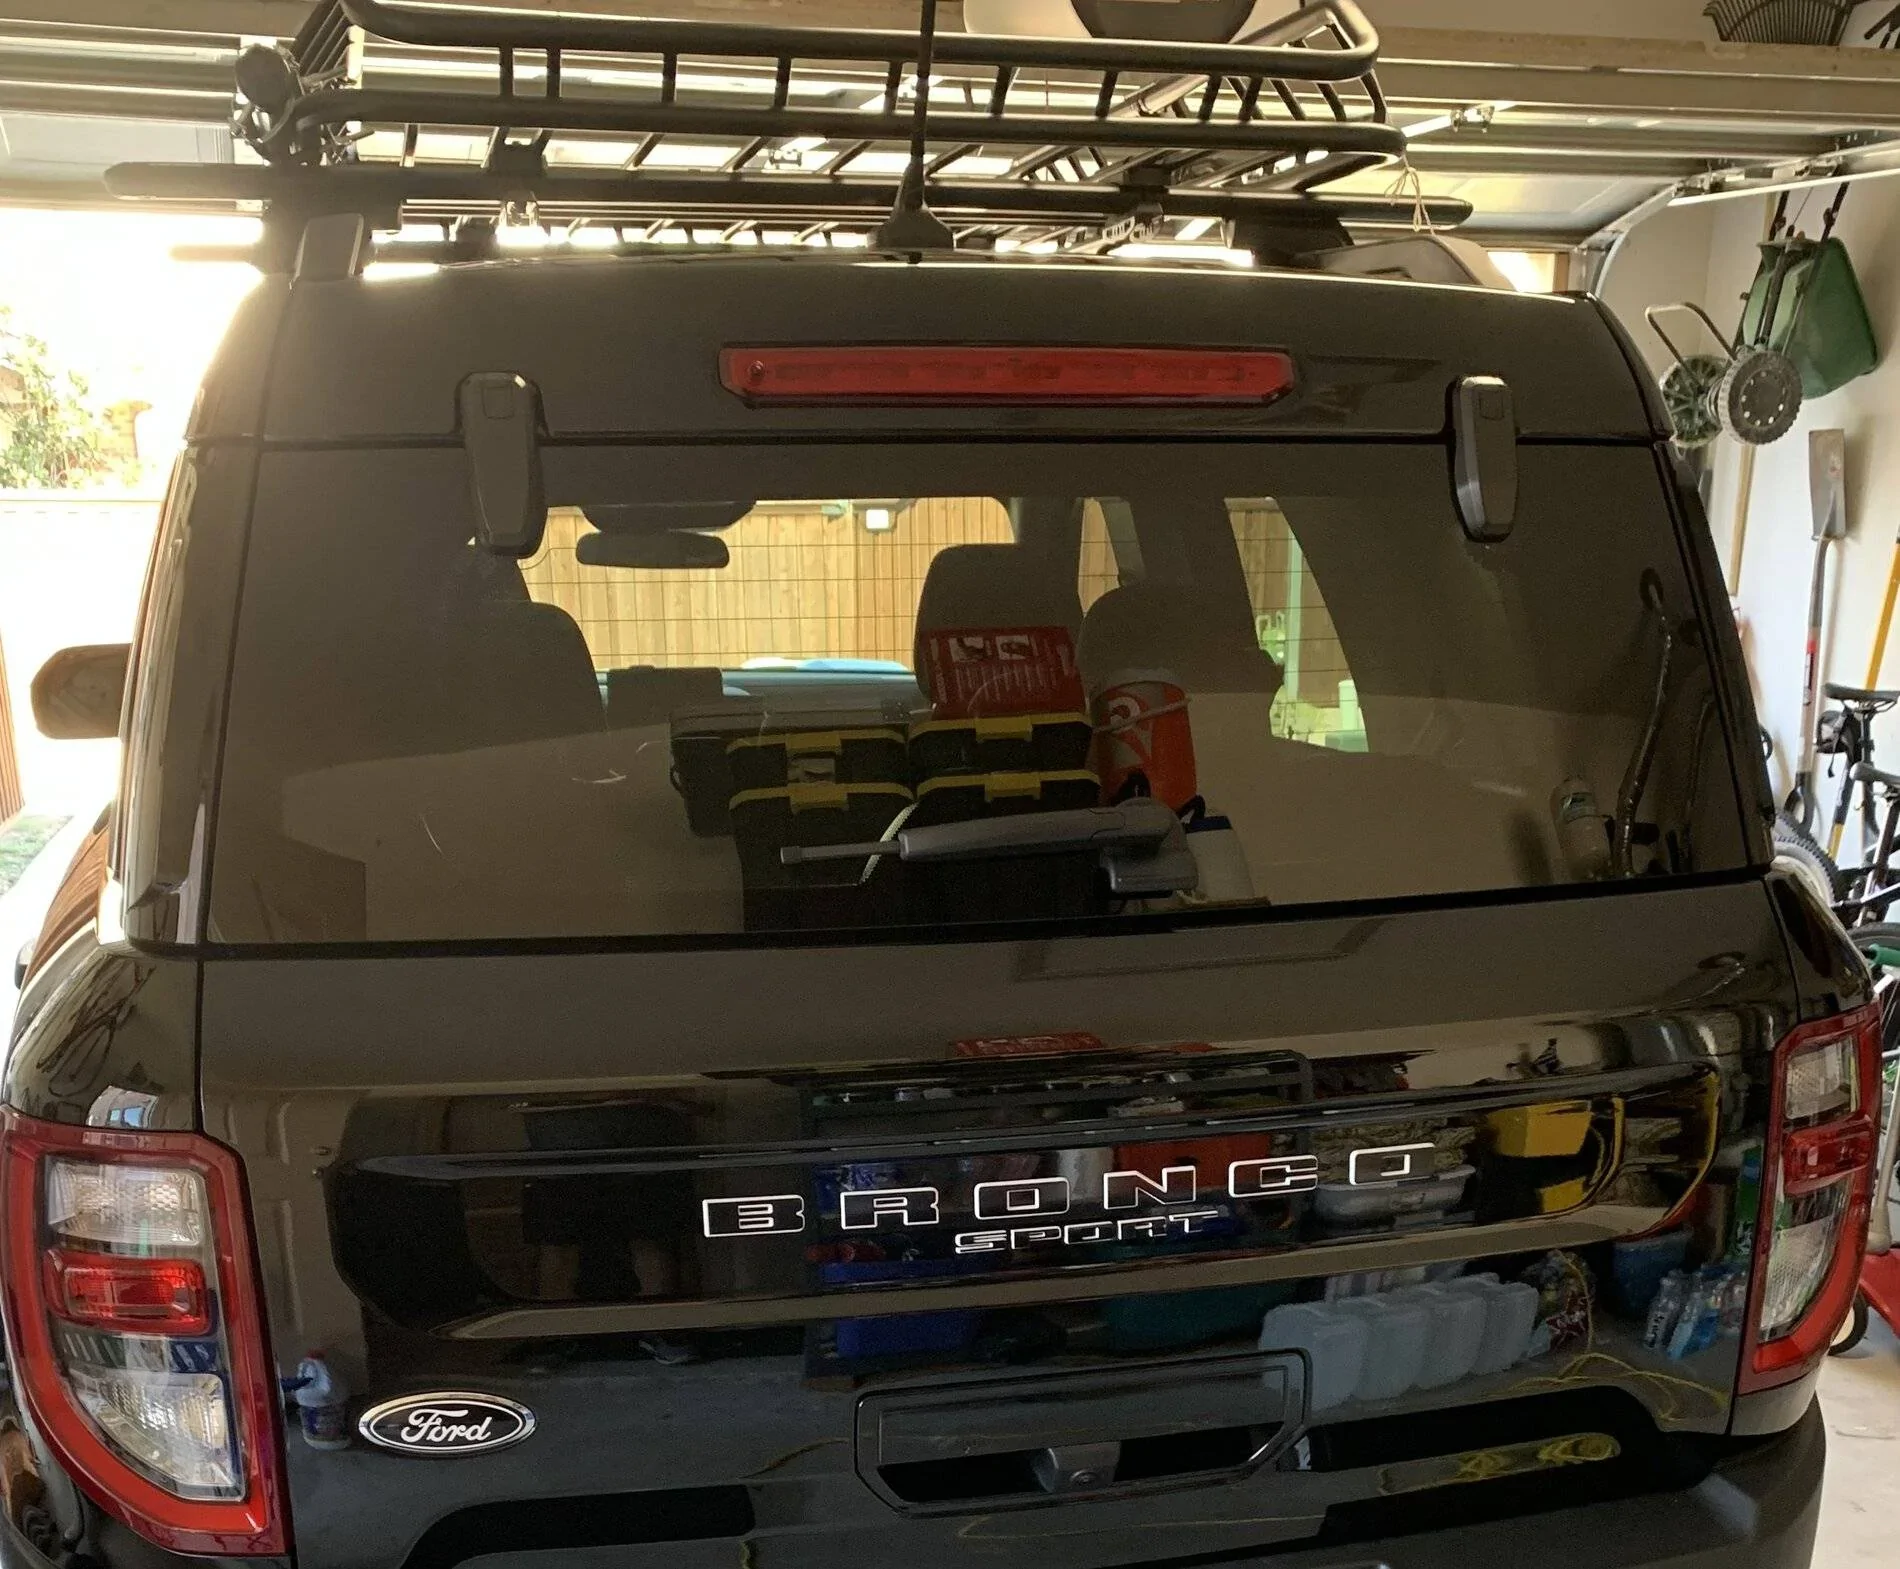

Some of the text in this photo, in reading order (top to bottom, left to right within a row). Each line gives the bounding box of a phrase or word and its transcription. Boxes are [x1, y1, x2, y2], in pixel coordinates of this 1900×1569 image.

[702, 1141, 1436, 1238] BRONCO
[954, 1209, 1218, 1256] SPORT
[400, 1408, 492, 1443] Ford
